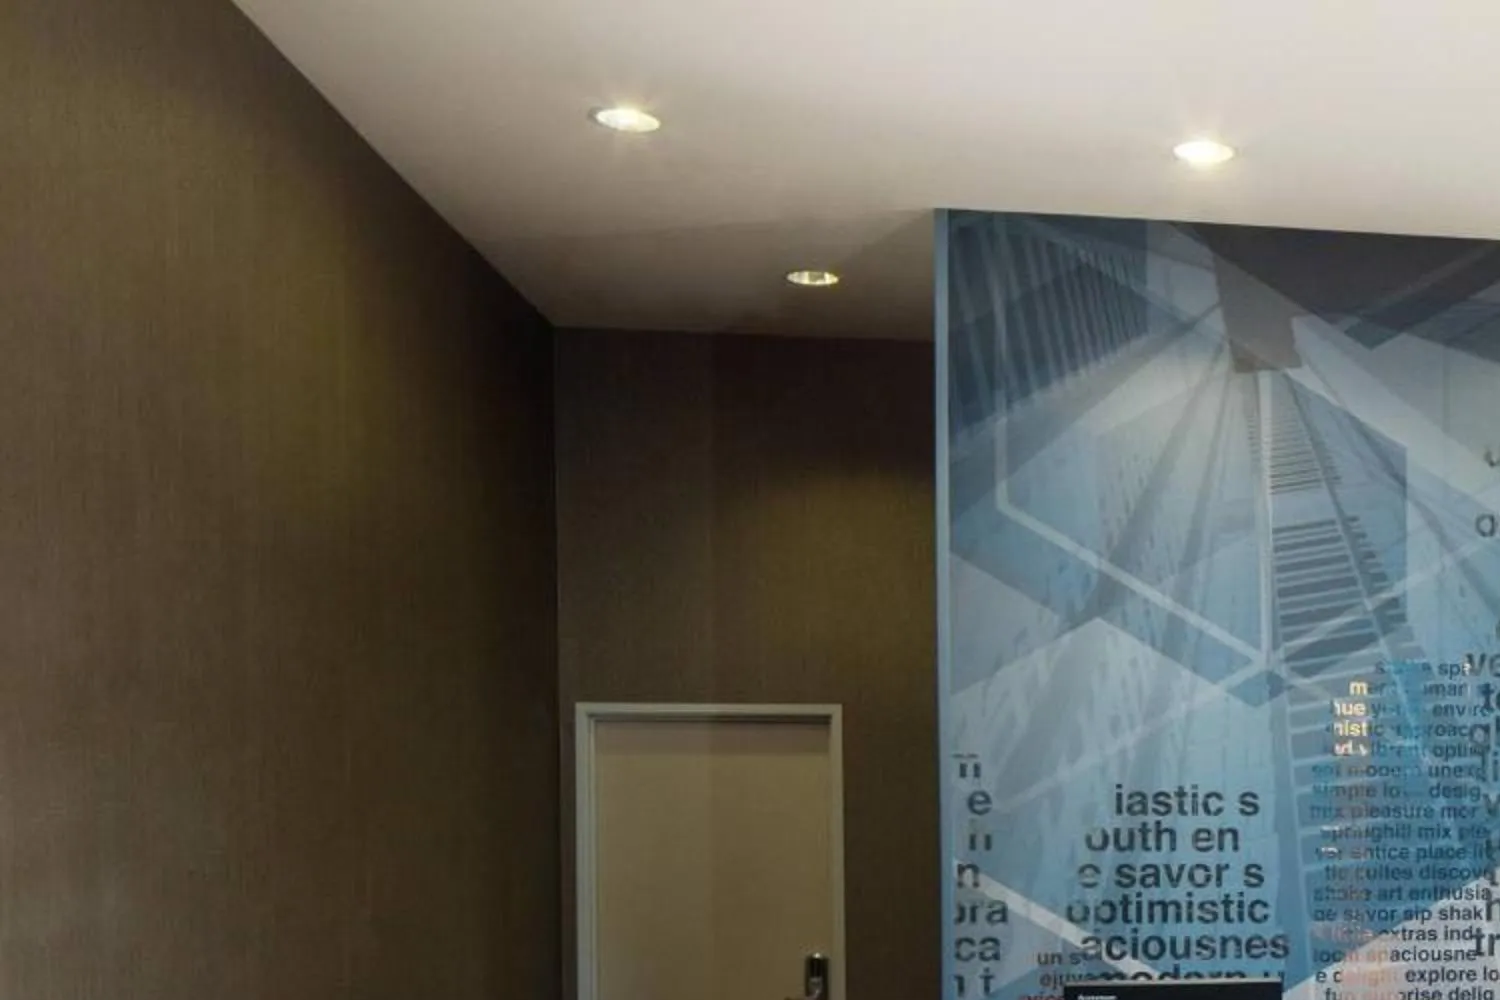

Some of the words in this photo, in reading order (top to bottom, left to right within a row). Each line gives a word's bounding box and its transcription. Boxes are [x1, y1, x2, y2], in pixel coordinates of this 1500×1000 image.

[967, 789, 992, 815] e
[1115, 784, 1224, 816] iastic
[1238, 791, 1260, 816] s
[1086, 820, 1176, 852] outh
[1191, 828, 1239, 852] en
[1418, 825, 1452, 838] mix
[1114, 863, 1229, 888] savor
[1243, 863, 1264, 888] s
[1066, 892, 1269, 924] optimistic
[1439, 906, 1483, 921] shak
[954, 937, 1001, 962] ca
[1081, 928, 1290, 961] aciousnes
[1405, 966, 1476, 986] explore
